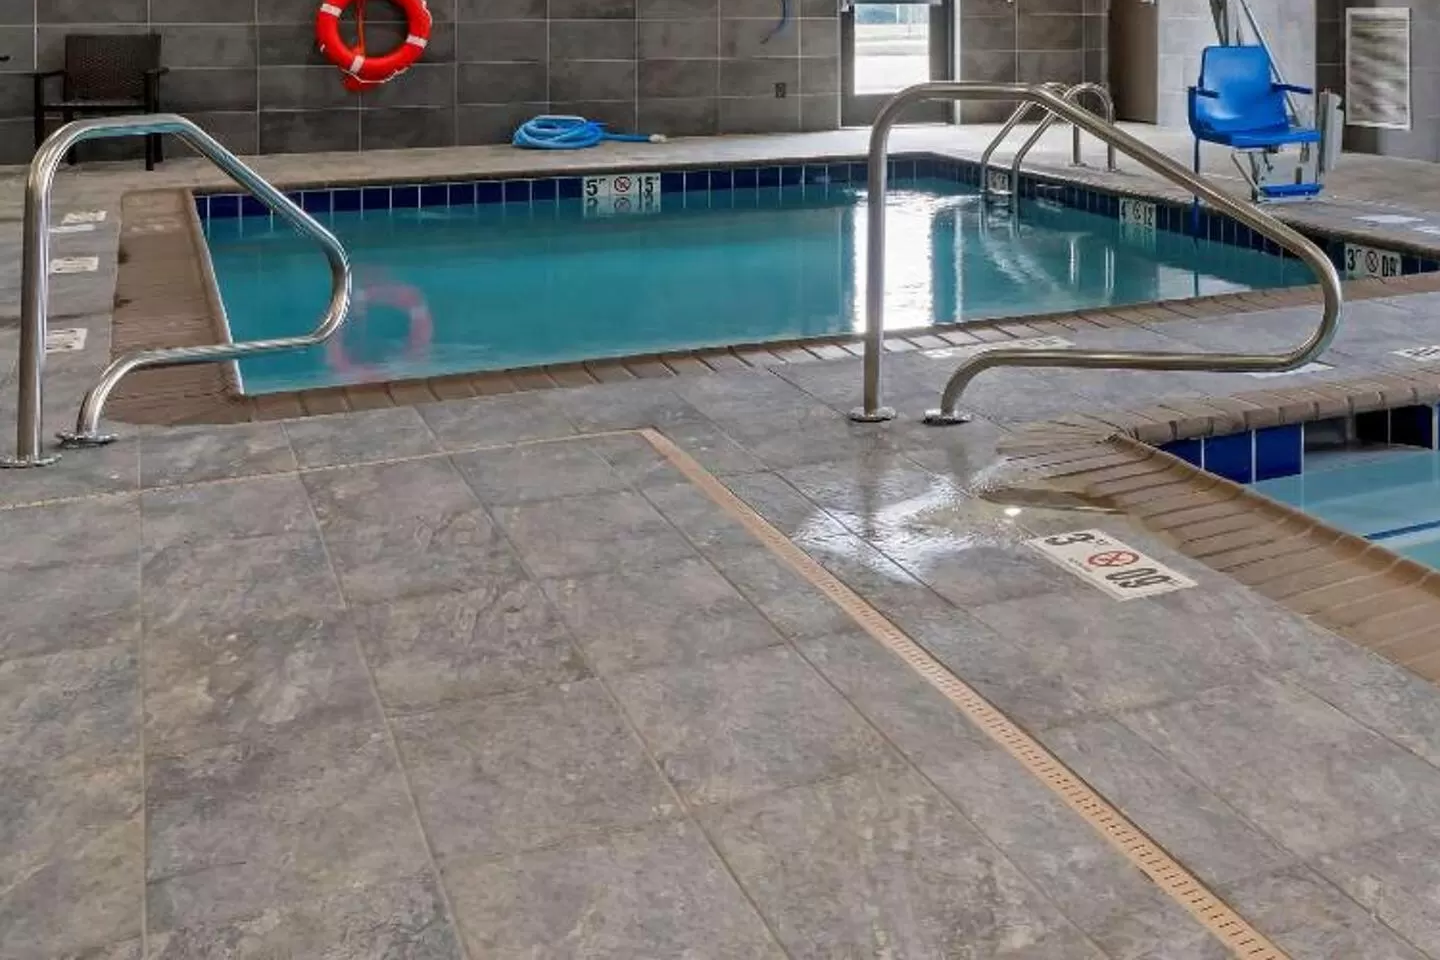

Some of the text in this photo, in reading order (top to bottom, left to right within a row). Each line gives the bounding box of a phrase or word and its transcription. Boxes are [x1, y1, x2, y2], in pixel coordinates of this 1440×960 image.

[586, 179, 598, 196] 5
[1347, 248, 1356, 271] 3
[1044, 533, 1095, 546] 3
